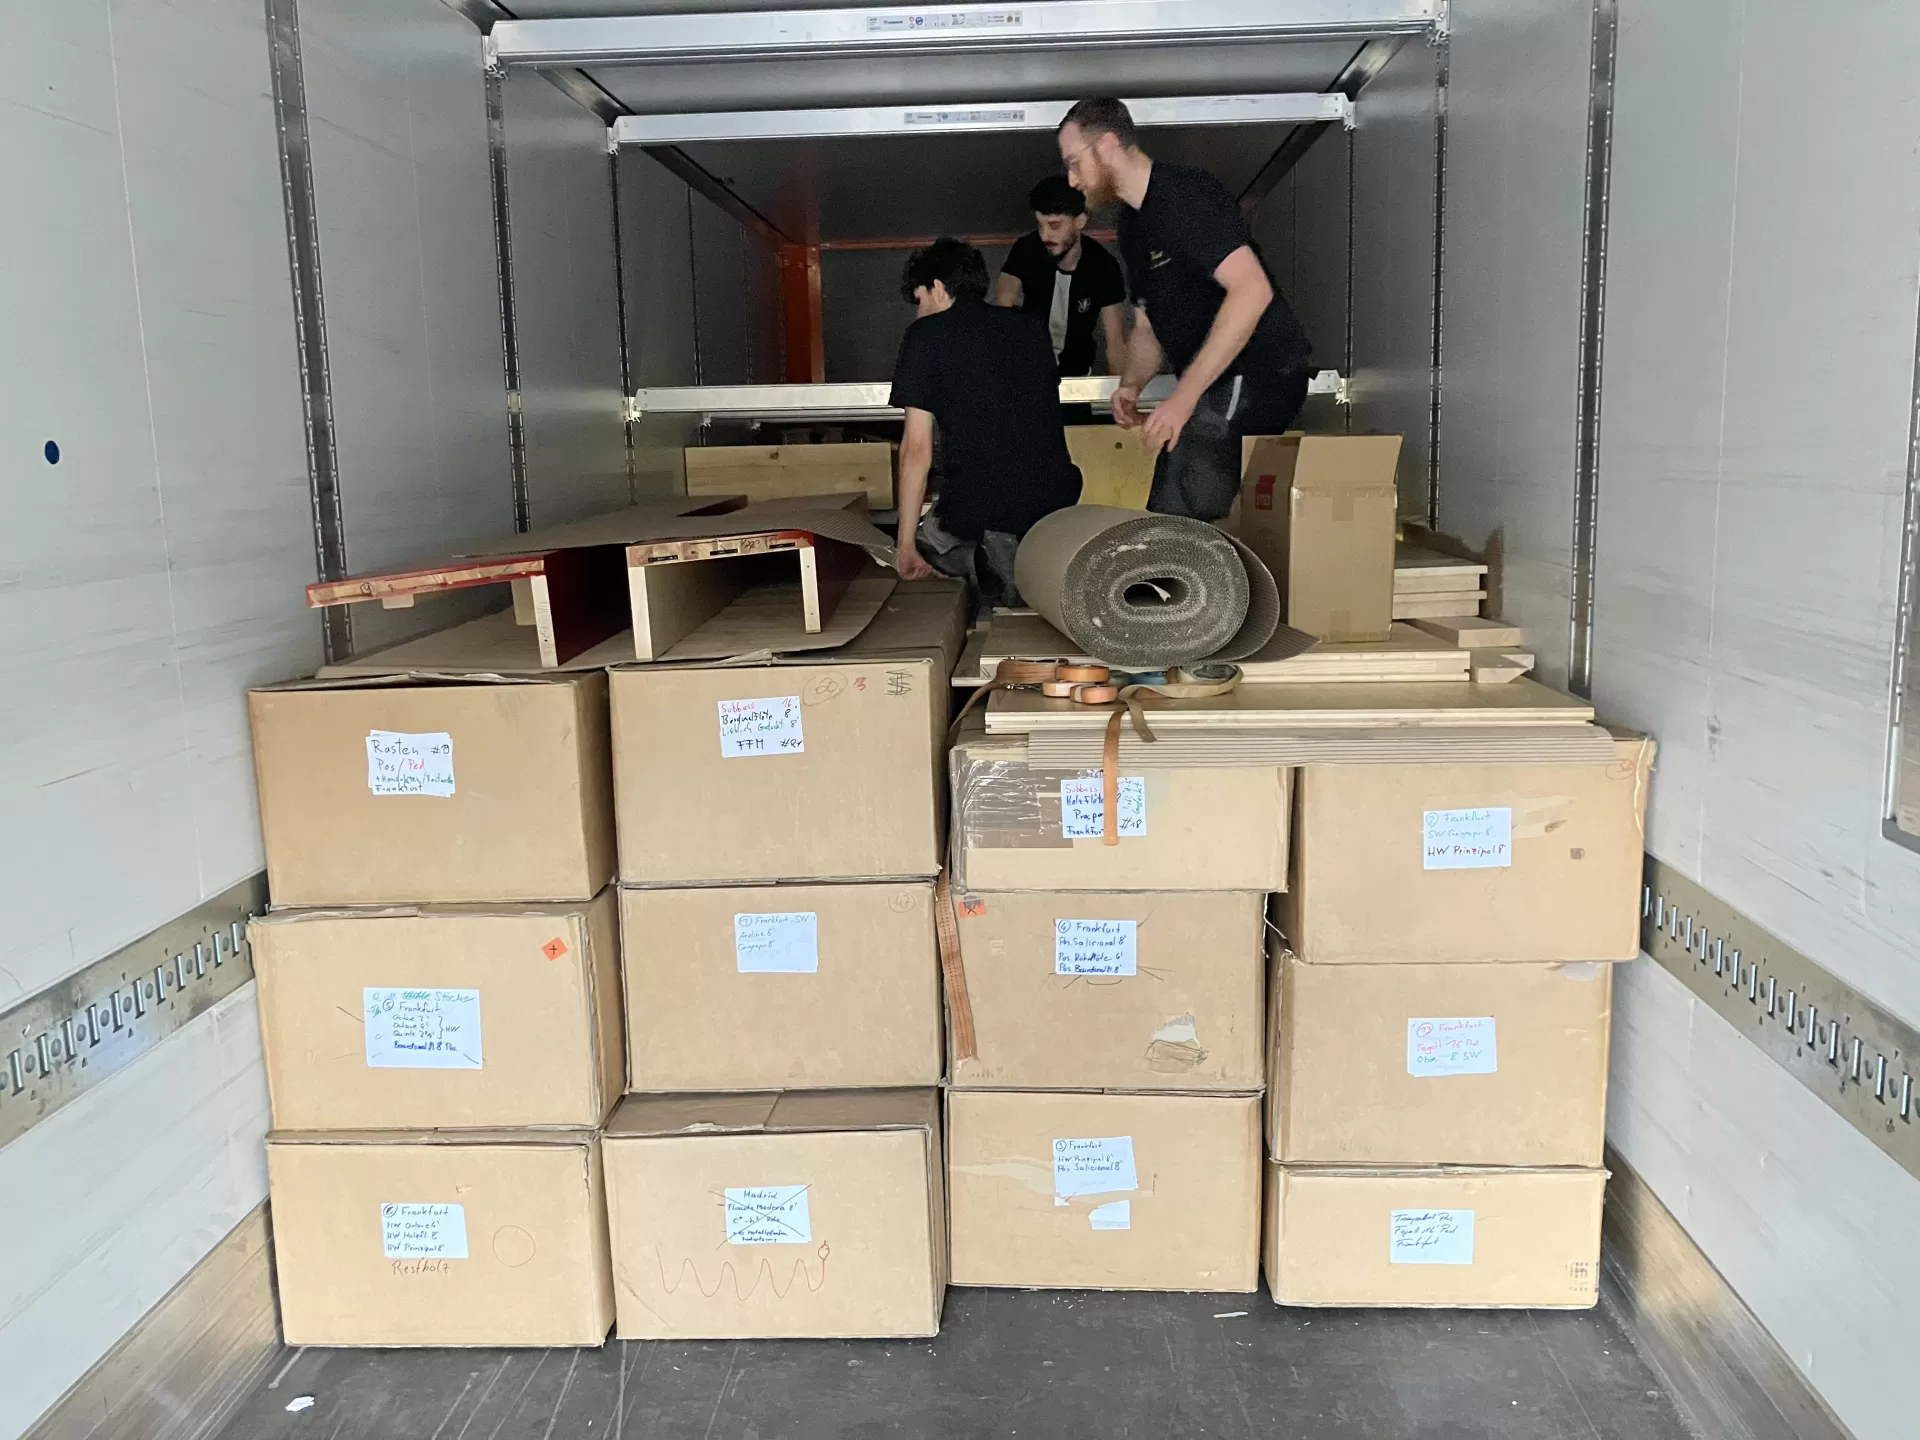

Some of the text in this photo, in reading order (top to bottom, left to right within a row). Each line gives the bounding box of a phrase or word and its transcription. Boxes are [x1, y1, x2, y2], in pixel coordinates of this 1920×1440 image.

[721, 701, 756, 713] Subbass
[1444, 810, 1492, 822] Frankfurt
[1428, 845, 1450, 856] HW
[1076, 921, 1121, 933] Frankfurt
[1058, 952, 1070, 961] Pos
[1059, 963, 1071, 972] Pos
[399, 1001, 442, 1013] Frankfurt
[1463, 1049, 1485, 1061] SW
[743, 1190, 778, 1199] Madrid
[401, 1204, 449, 1216] Frankfurt
